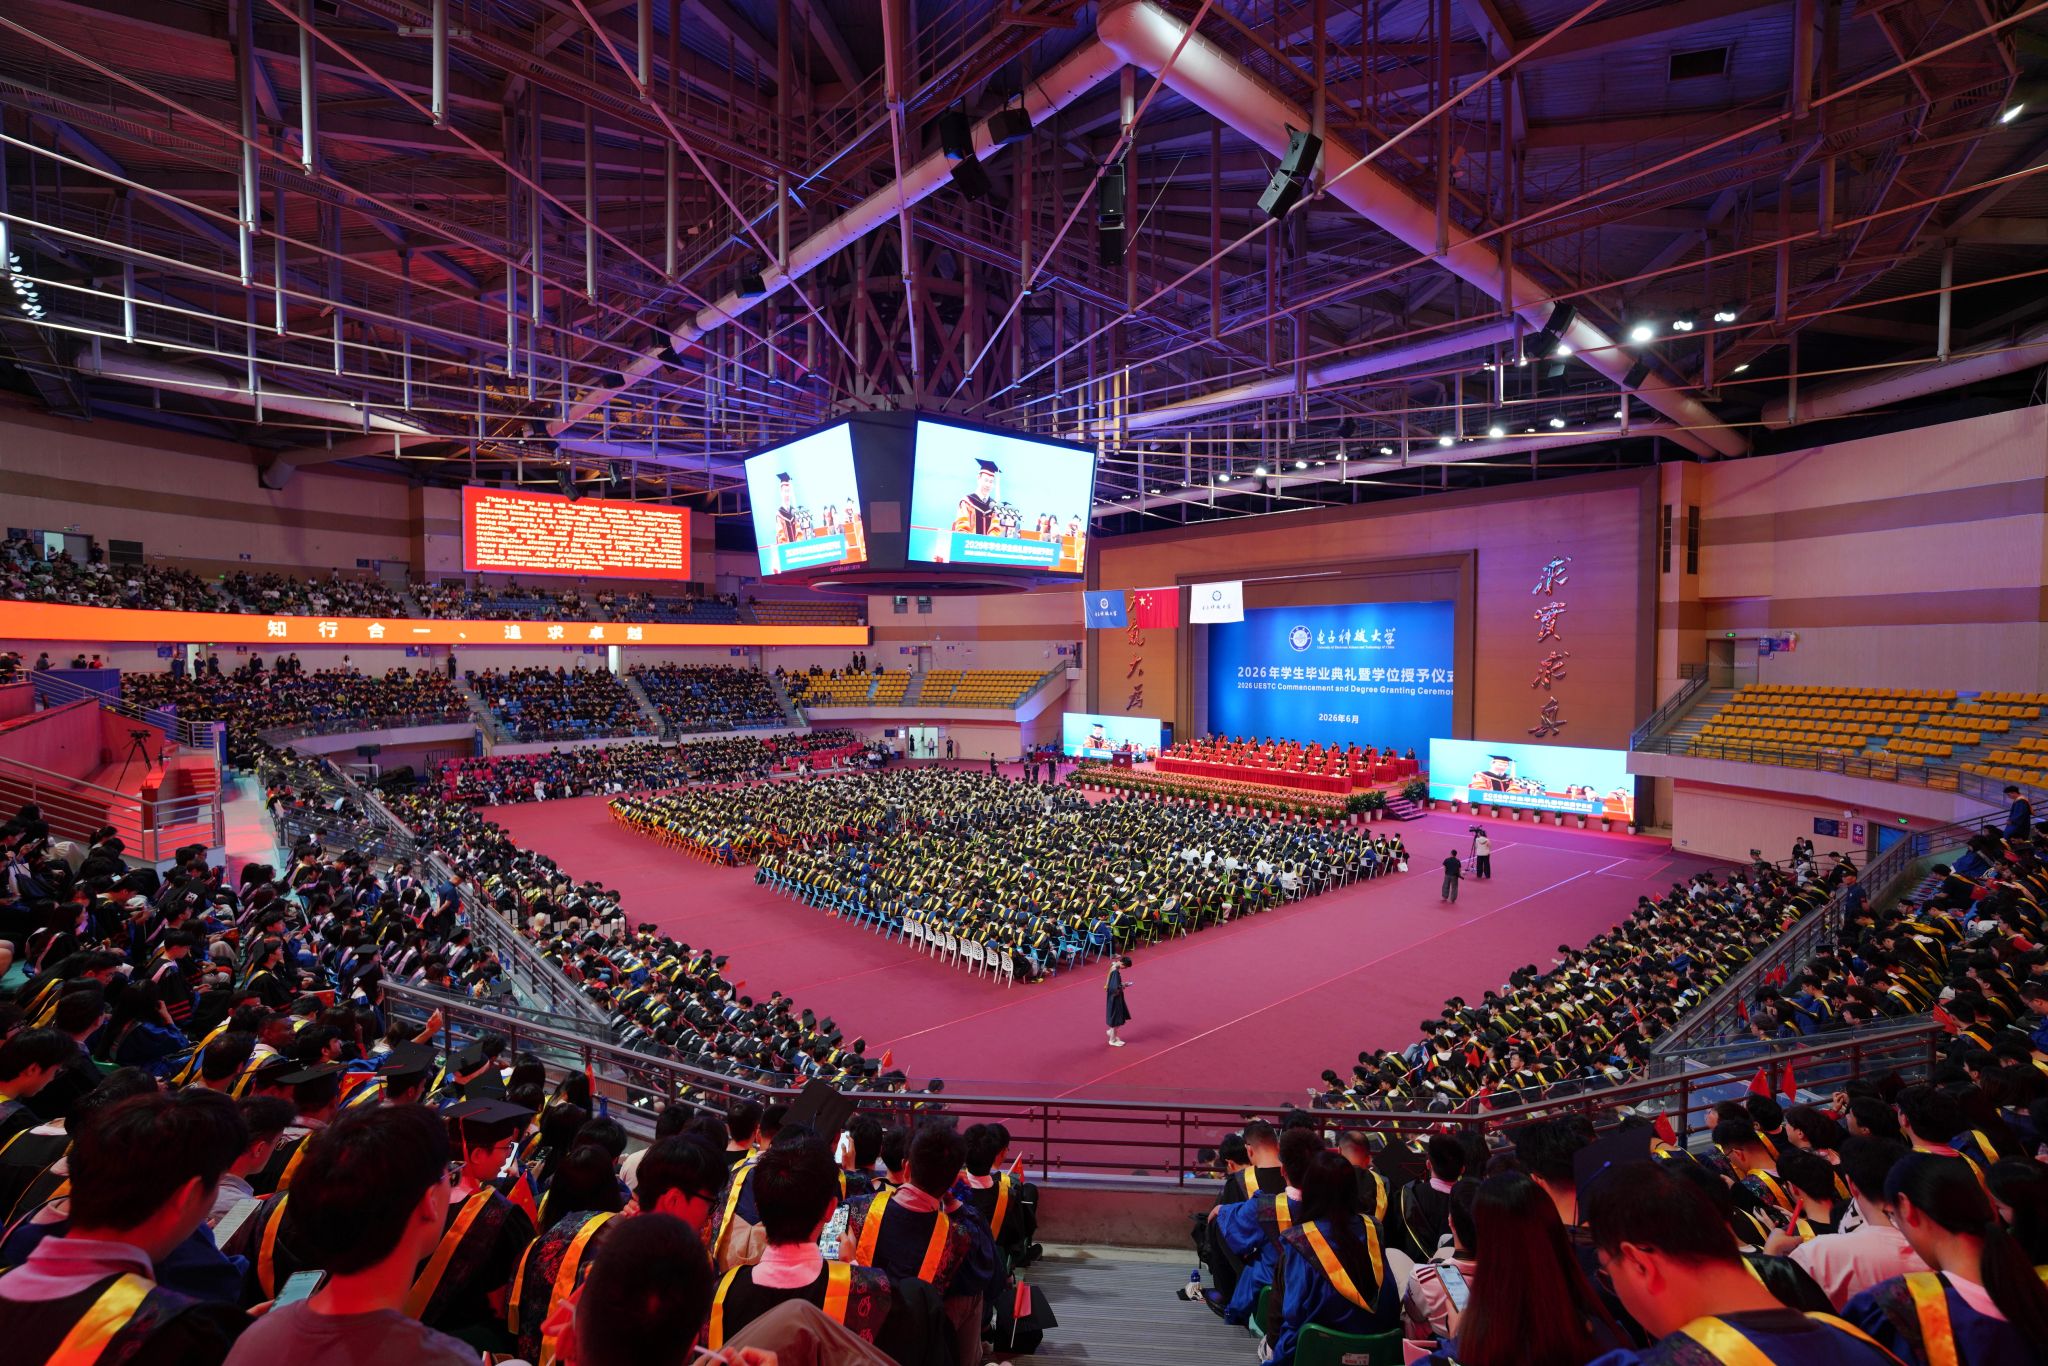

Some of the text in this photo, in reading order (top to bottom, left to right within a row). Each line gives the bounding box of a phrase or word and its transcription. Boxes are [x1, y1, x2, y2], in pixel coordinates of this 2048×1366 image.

[267, 620, 643, 641] 知行合一、追求卓越
[1317, 628, 1396, 645] 电子科技大学
[1278, 684, 1334, 692] Commencement
[1351, 686, 1378, 694] Degree
[1380, 686, 1415, 696] Granting
[1318, 713, 1360, 724] 2026年6月
